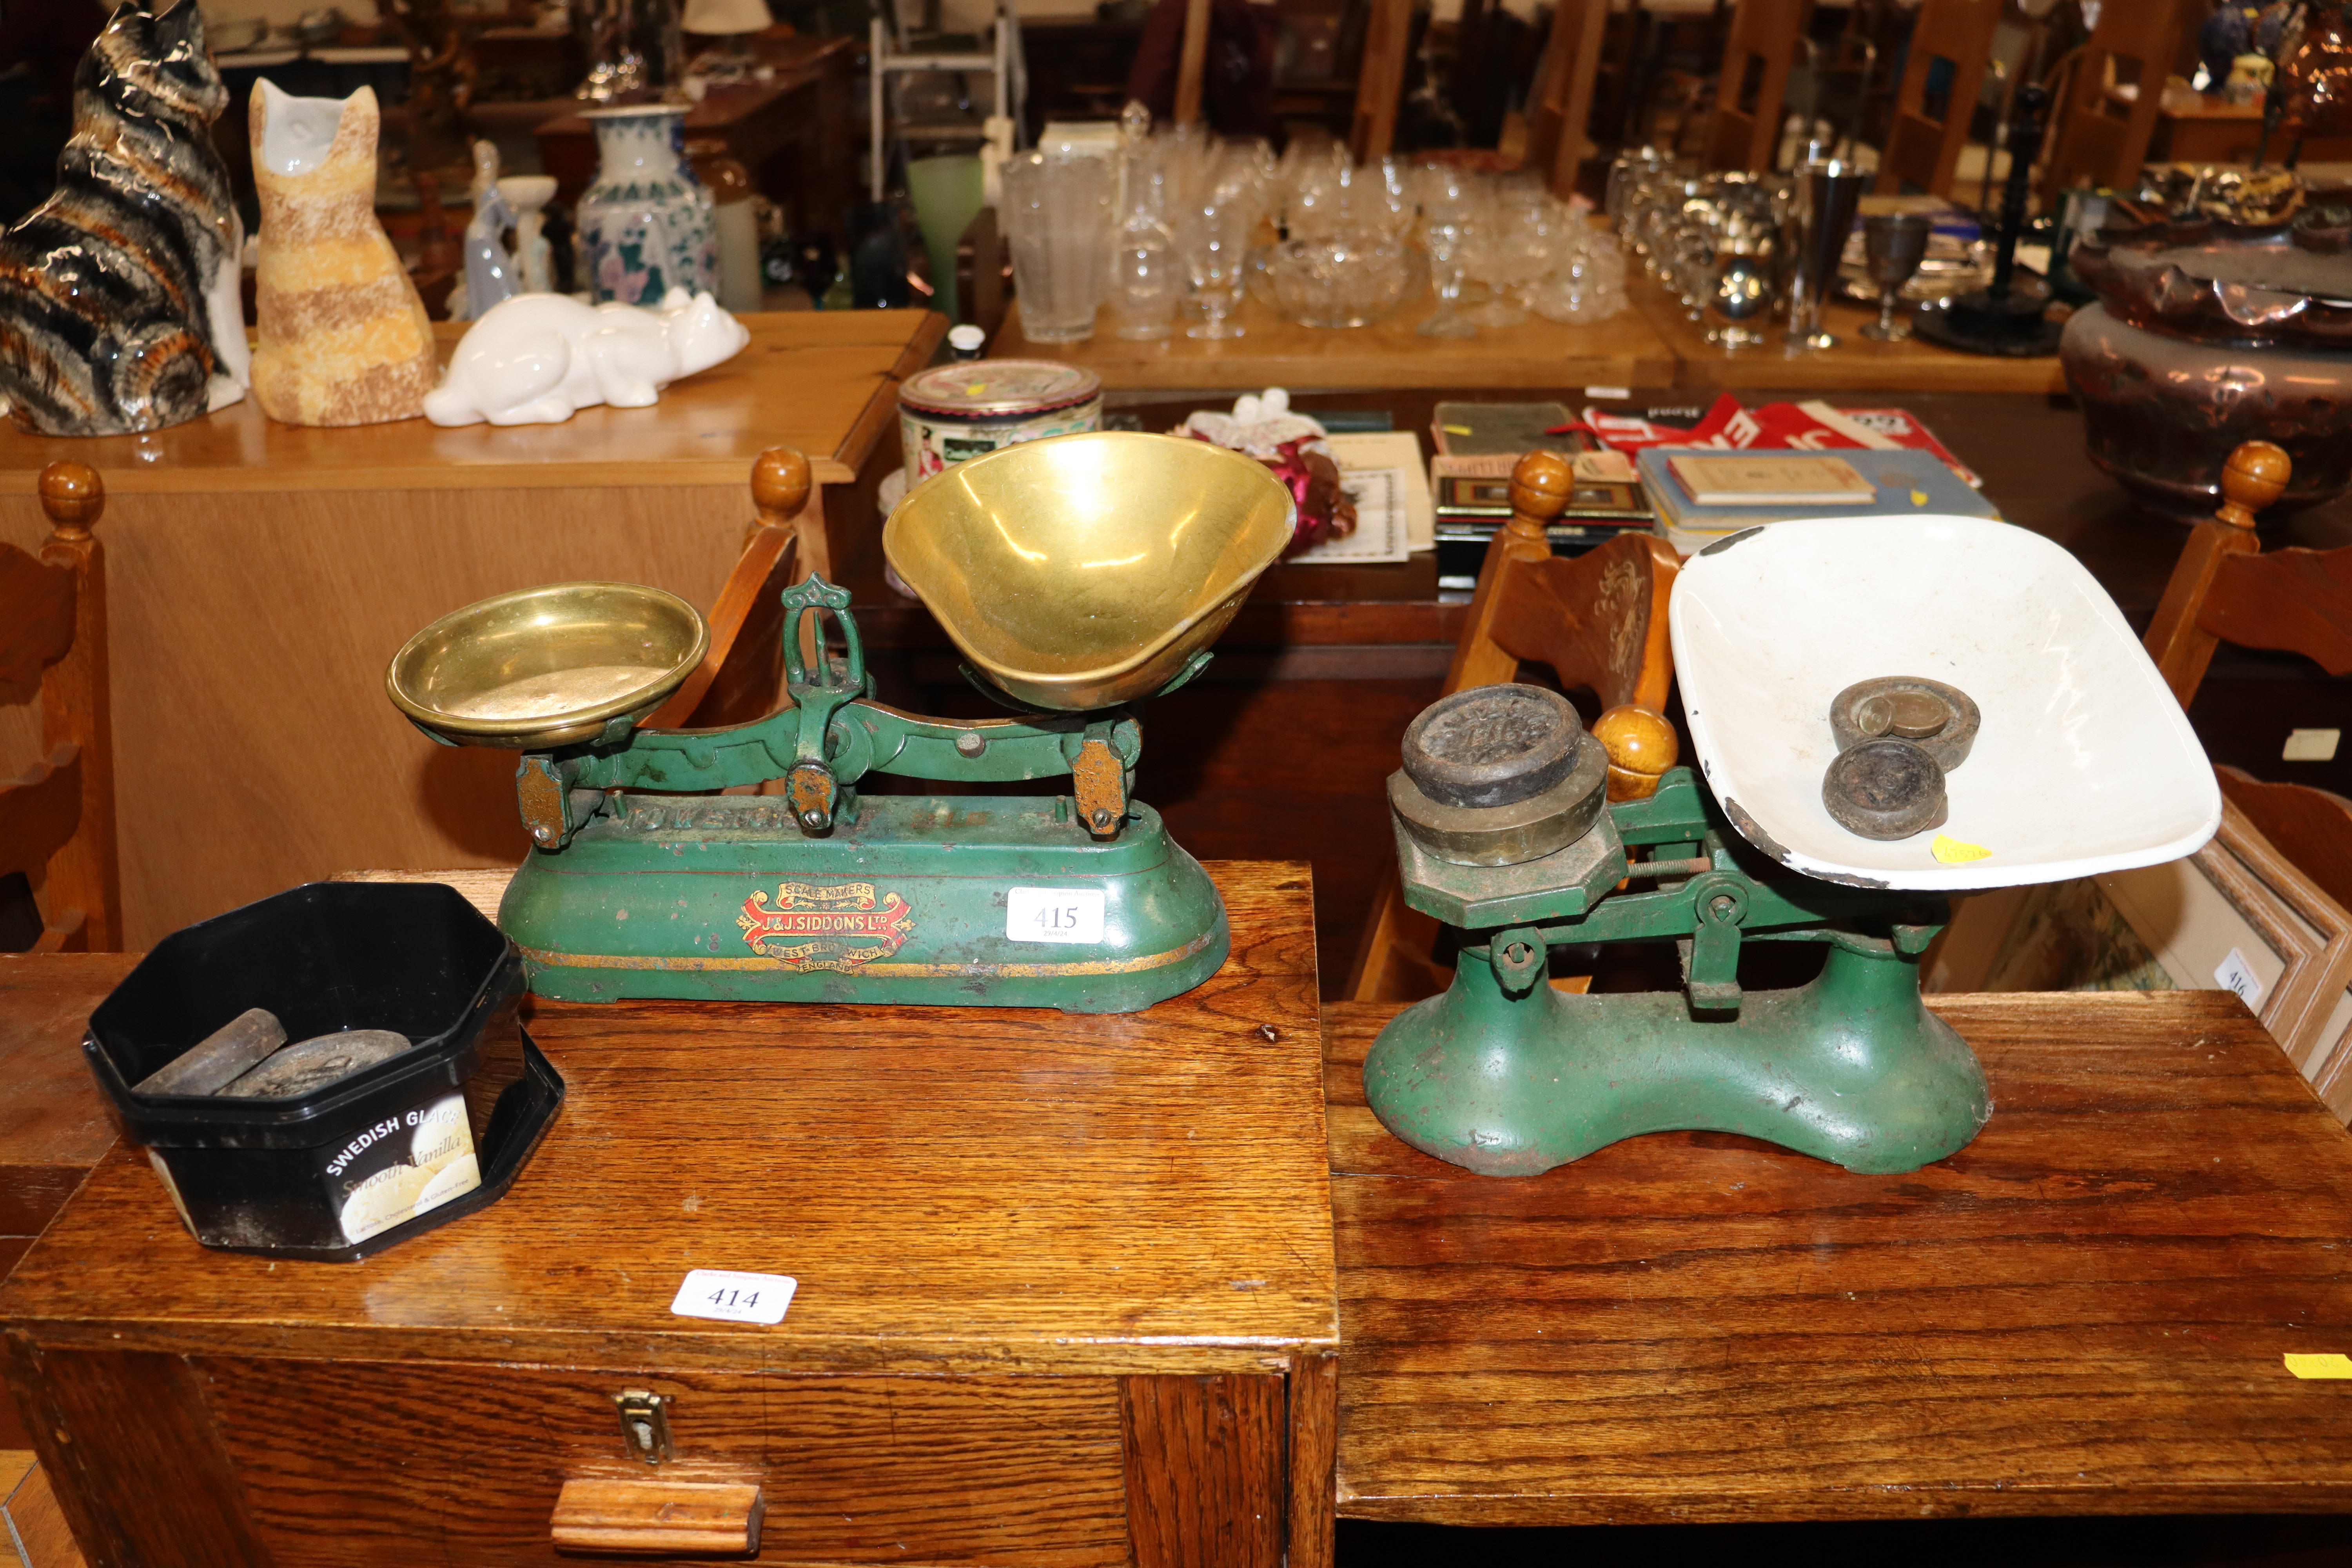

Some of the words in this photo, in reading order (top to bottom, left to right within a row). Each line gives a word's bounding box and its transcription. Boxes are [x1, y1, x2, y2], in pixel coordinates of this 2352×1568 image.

[786, 884, 821, 898] SCALE
[826, 885, 870, 899] MAKERS
[1034, 906, 1079, 929] 415
[803, 962, 851, 972] ENGLAND
[2229, 971, 2248, 998] 416
[327, 1117, 400, 1177] SWEDISH
[406, 1108, 462, 1126] GLACE
[342, 1160, 403, 1198] Smooth
[408, 1136, 461, 1168] Vanilla
[762, 1276, 791, 1284] Auctions
[708, 1288, 760, 1308] 414
